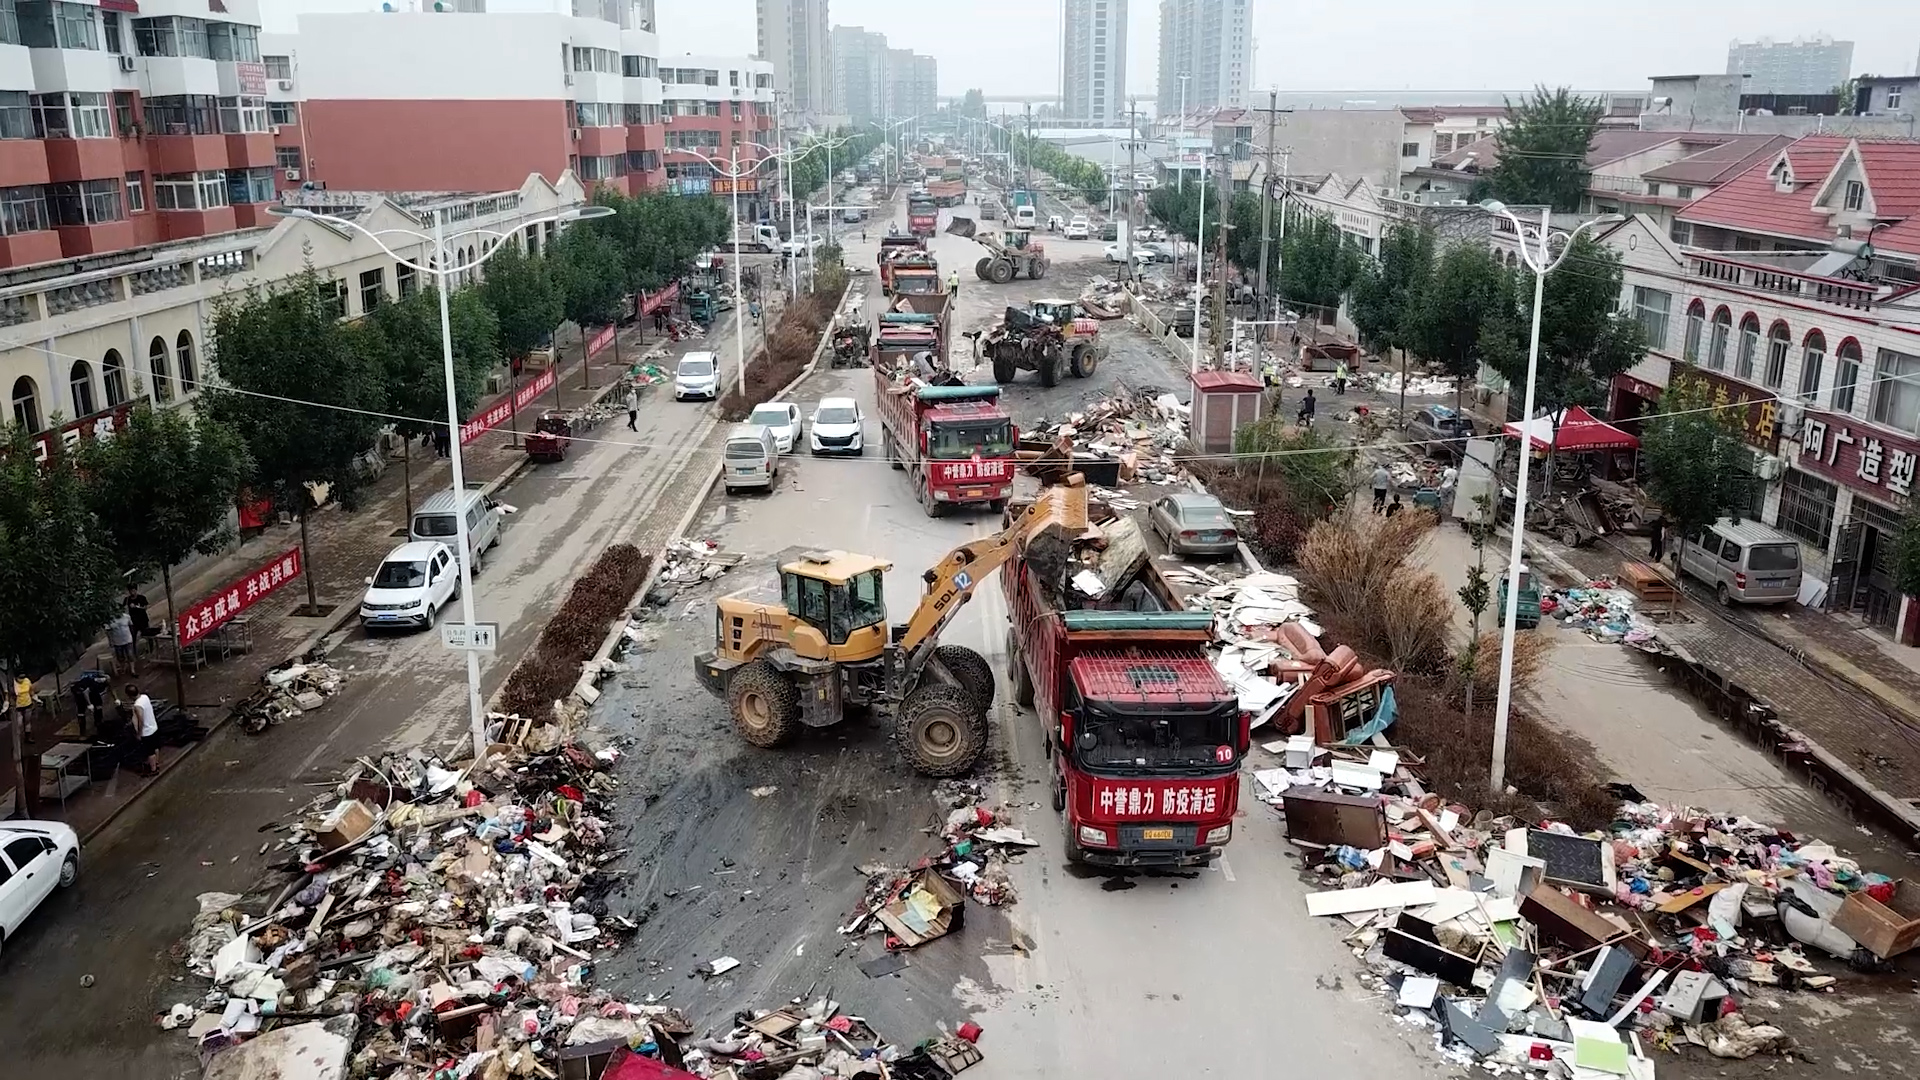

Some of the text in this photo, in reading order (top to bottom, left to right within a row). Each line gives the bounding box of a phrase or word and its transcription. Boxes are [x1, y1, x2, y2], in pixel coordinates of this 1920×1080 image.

[1801, 418, 1917, 497] 阿广造型
[977, 461, 1005, 478] 防疫清运
[954, 572, 973, 589] 12
[185, 589, 240, 639] 众志成城
[1216, 748, 1232, 761] 10
[1100, 786, 1217, 816] 中誉鼎力 防疫清运
